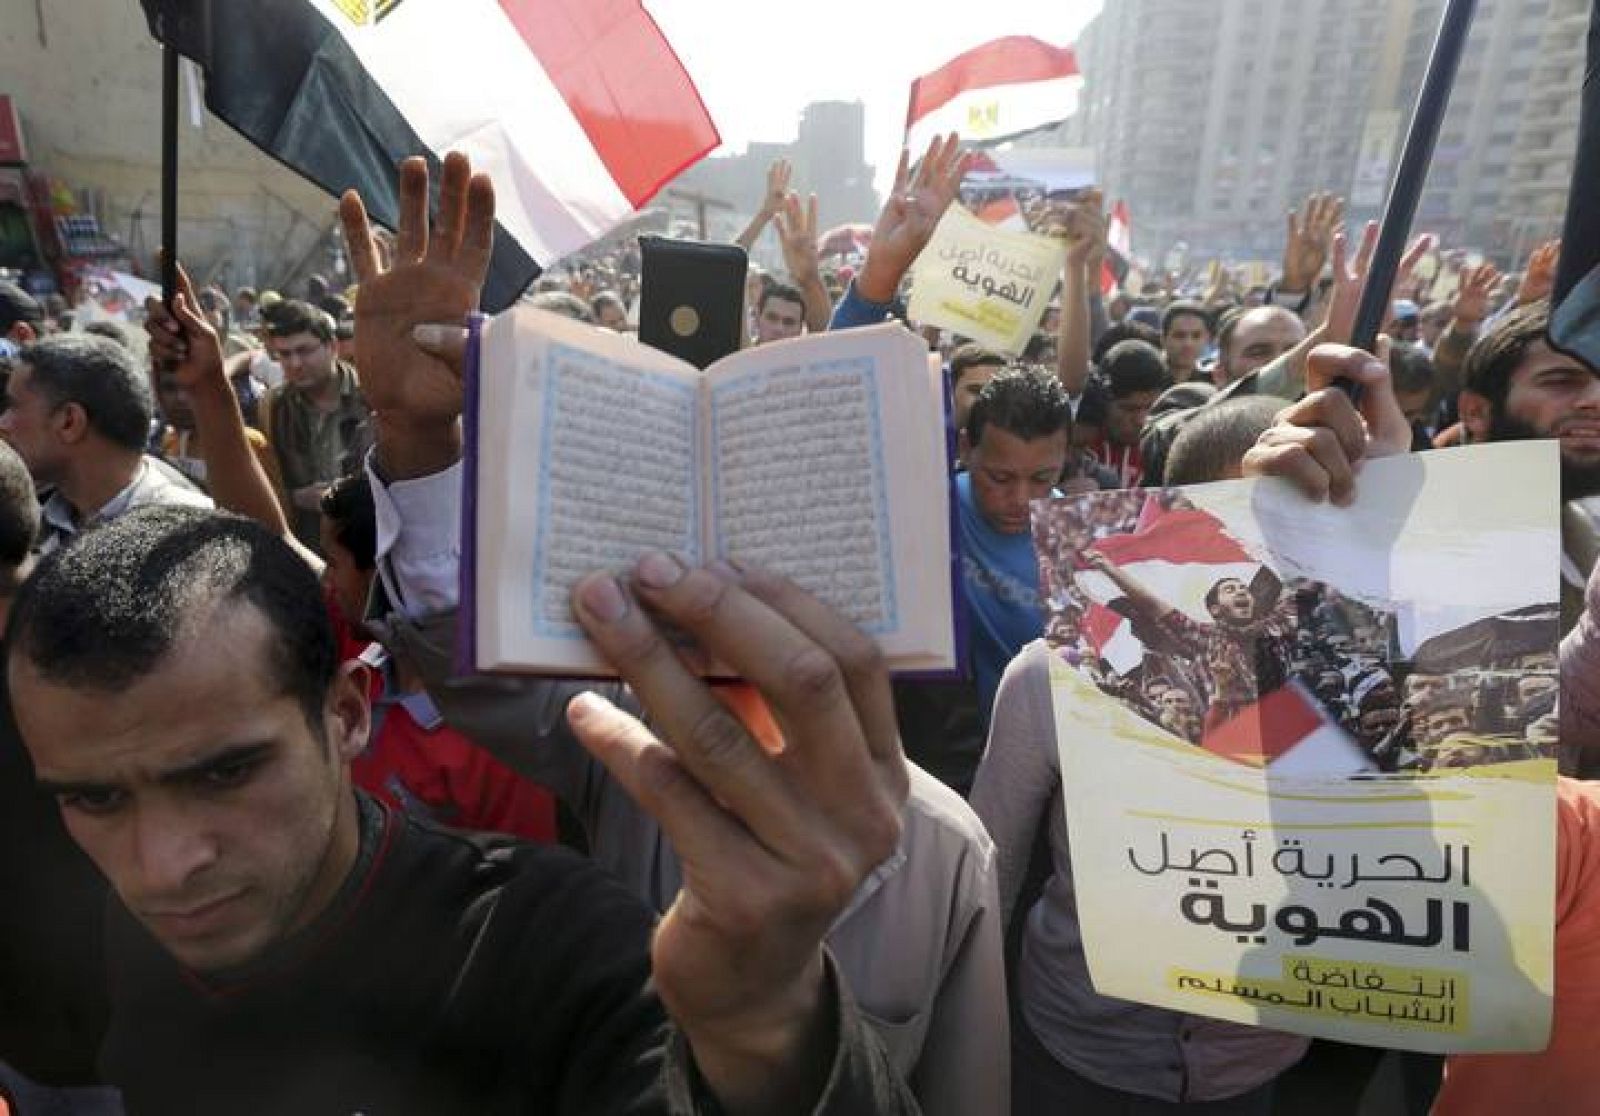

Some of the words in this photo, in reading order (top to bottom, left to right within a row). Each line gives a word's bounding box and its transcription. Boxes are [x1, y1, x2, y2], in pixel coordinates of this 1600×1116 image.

[952, 260, 1035, 309] الهوية
[1127, 829, 1256, 877] أصل
[1272, 838, 1470, 889] الحرية
[1179, 877, 1470, 953] الهوية
[1178, 974, 1322, 1009] المسلم
[1329, 995, 1455, 1026] الشباب
